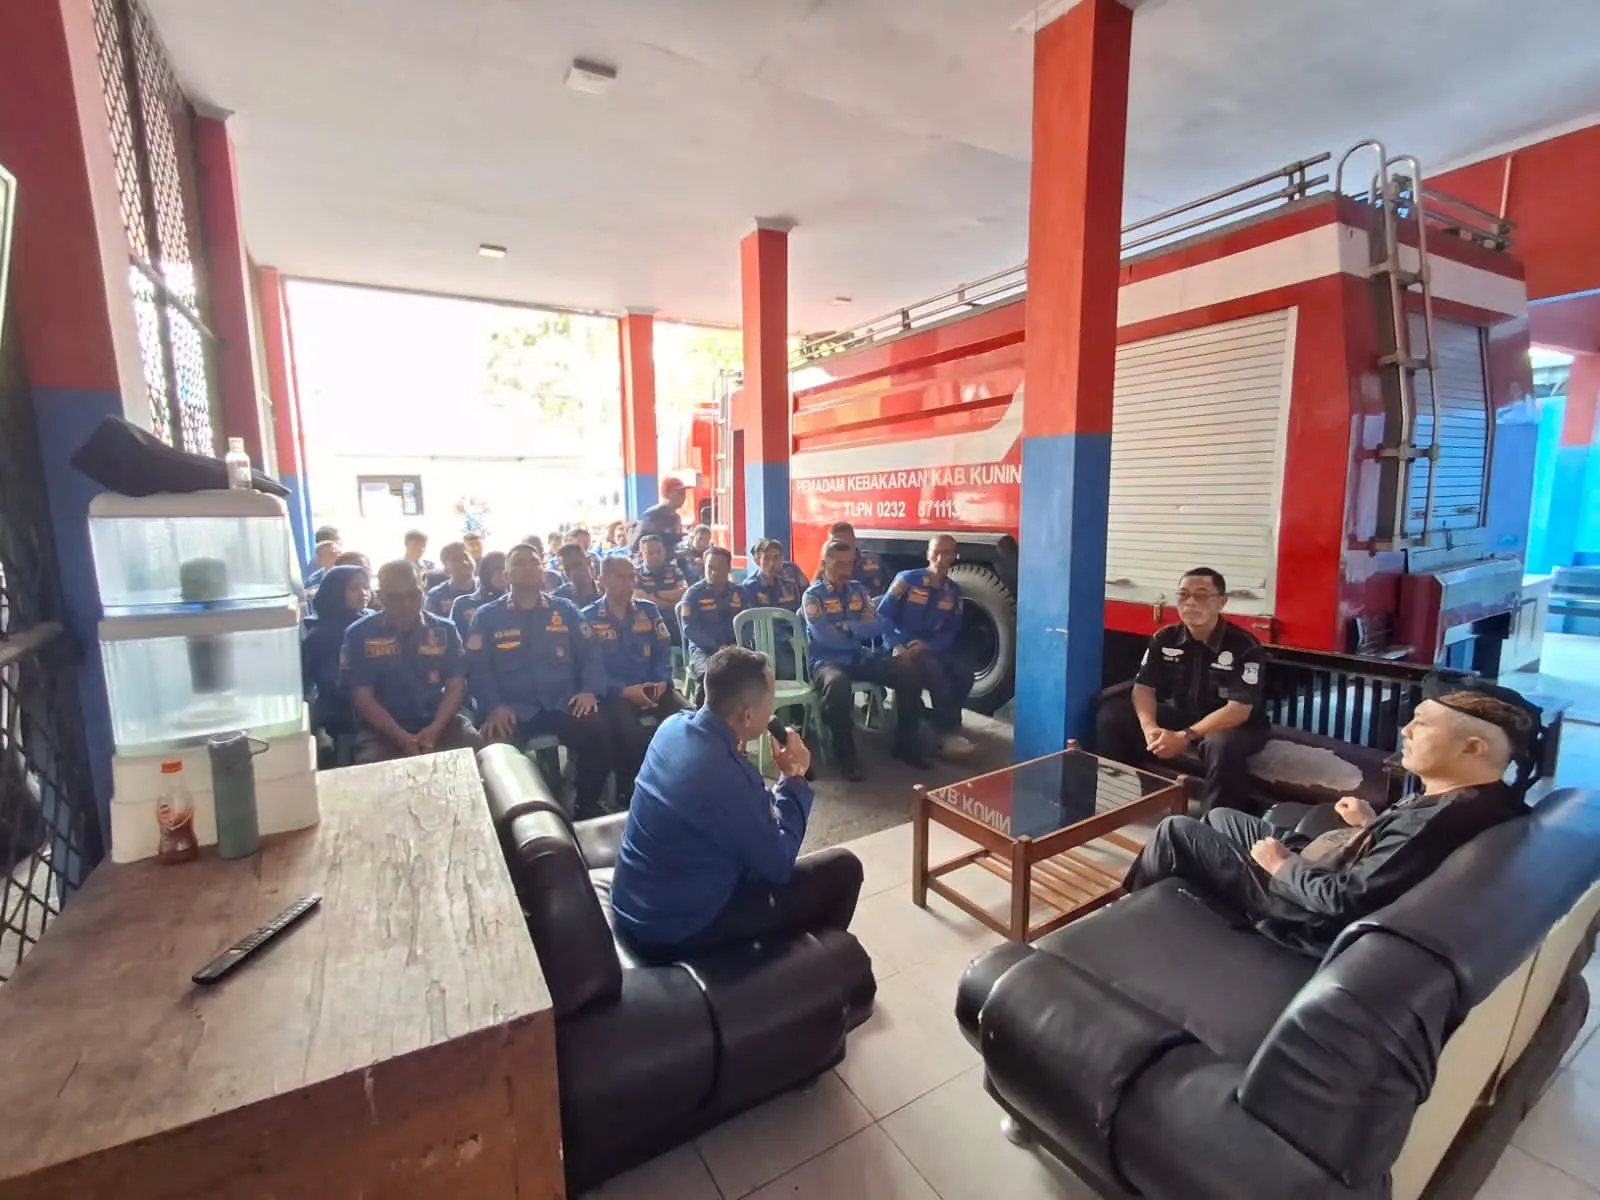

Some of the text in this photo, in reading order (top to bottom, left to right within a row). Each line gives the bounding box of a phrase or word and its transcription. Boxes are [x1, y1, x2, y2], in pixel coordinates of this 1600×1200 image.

[796, 476, 845, 494] PEMADAM
[847, 470, 928, 491] KEBAKARAN
[969, 464, 1022, 485] KUNIN
[876, 500, 906, 518] 0232
